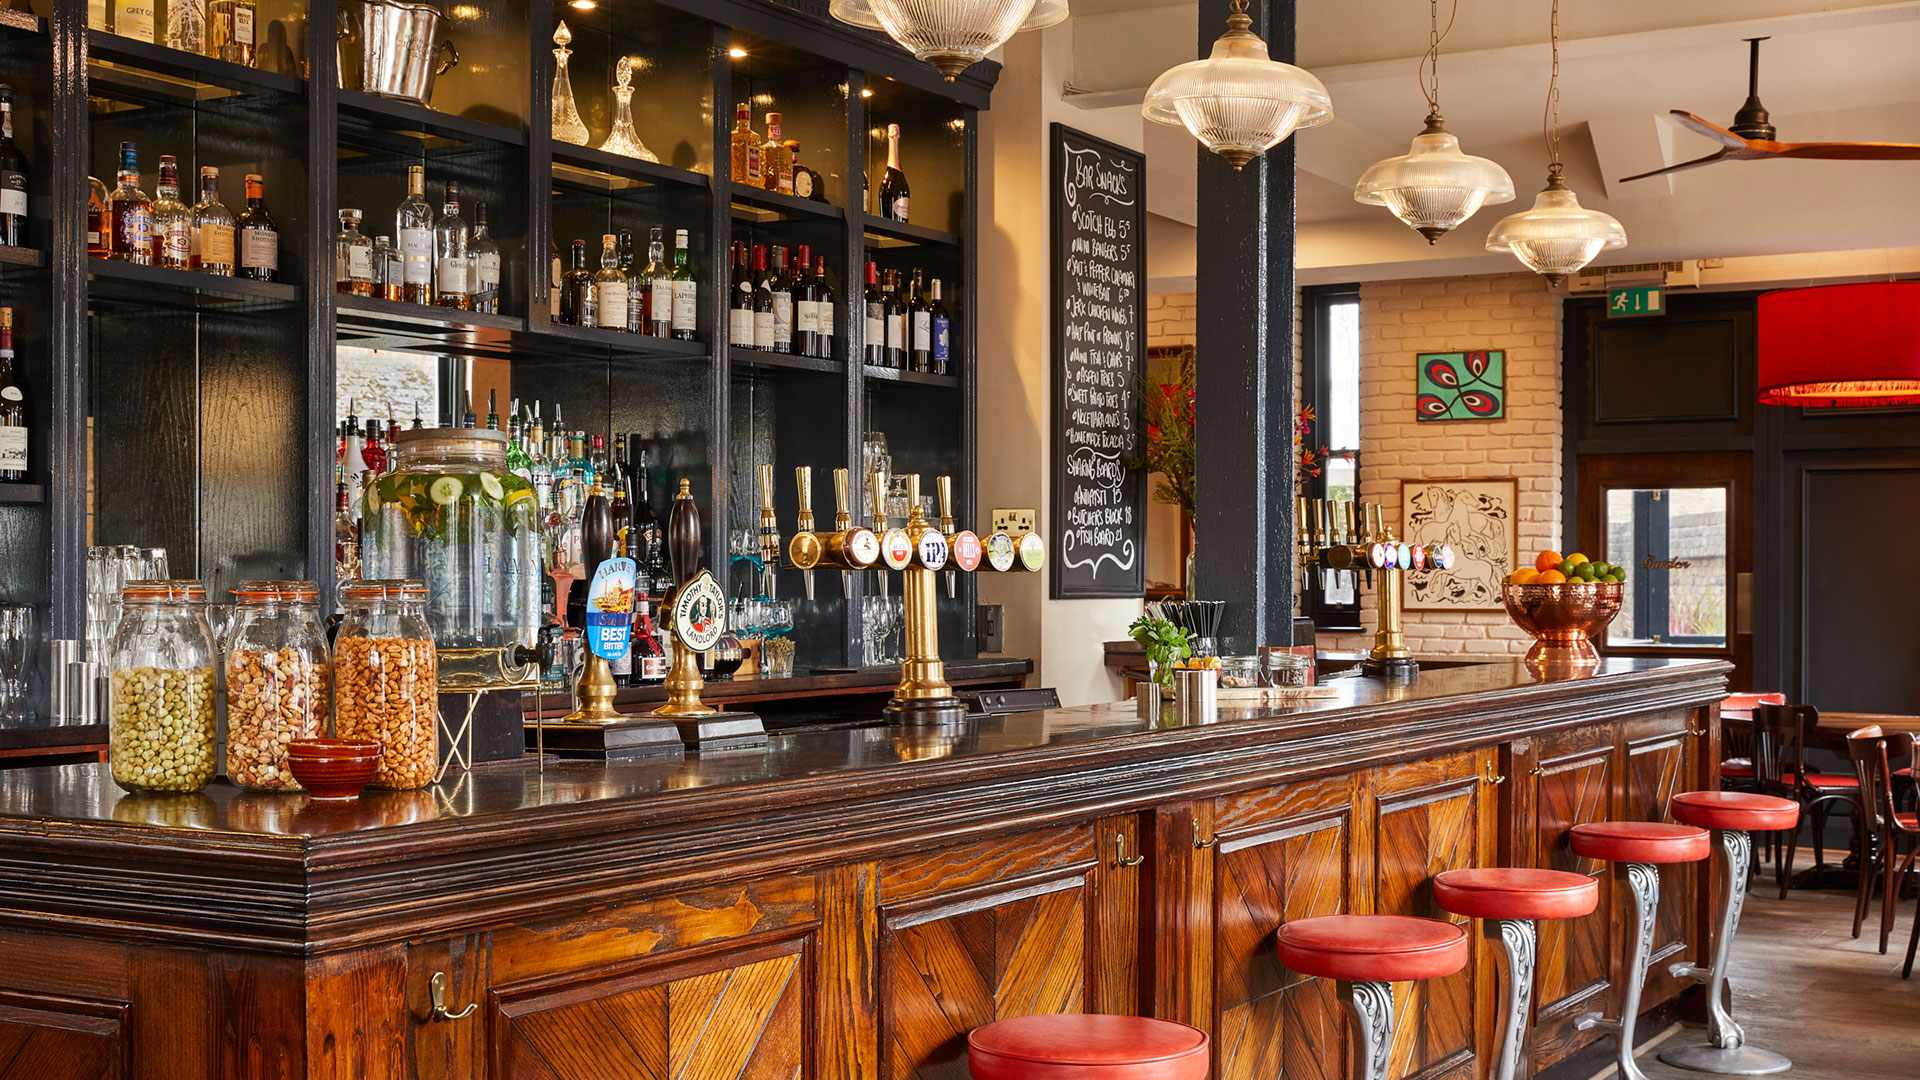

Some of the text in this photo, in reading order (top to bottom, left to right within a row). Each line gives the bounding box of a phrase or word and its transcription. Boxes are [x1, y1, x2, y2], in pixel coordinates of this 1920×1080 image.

[127, 7, 145, 16] GREY
[1075, 155, 1127, 195] BAR SNACKS
[1076, 204, 1102, 234] SCOTCH
[1104, 217, 1117, 239] EGG
[1091, 238, 1119, 262] BANGERS
[1071, 255, 1083, 276] SALT
[1089, 260, 1110, 283] PEPPER
[1082, 282, 1111, 302] WHITEBAIT
[1070, 295, 1135, 325] JERK CHICKEN WINGS 7
[1084, 322, 1097, 345] PINT
[1103, 326, 1124, 350] PRAWNS
[1090, 349, 1102, 366] FISH
[1107, 351, 1123, 369] CHIPS
[1100, 370, 1115, 387] FRIES
[1117, 371, 1125, 388] 5
[1071, 383, 1088, 404] SWEET
[1089, 386, 1106, 408] POTATO
[1105, 391, 1119, 409] FRIES
[1123, 412, 1131, 430] 3
[1070, 427, 1101, 448] HOMEMADE
[1067, 455, 1122, 482] SHARING BOARDS
[1077, 485, 1123, 506] ANTIPASTI 15
[1072, 506, 1104, 527] BUTCHERS
[1104, 508, 1123, 525] BLOCK
[1080, 527, 1093, 546] FISH
[1094, 527, 1115, 547] BOARD
[925, 541, 946, 564] IPA
[1641, 554, 1691, 570] Garden
[680, 583, 724, 621] TIMOTHY TAYLOR'S
[601, 627, 628, 642] BEST
[686, 626, 718, 644] LANDLORD
[603, 642, 624, 651] BITTER
